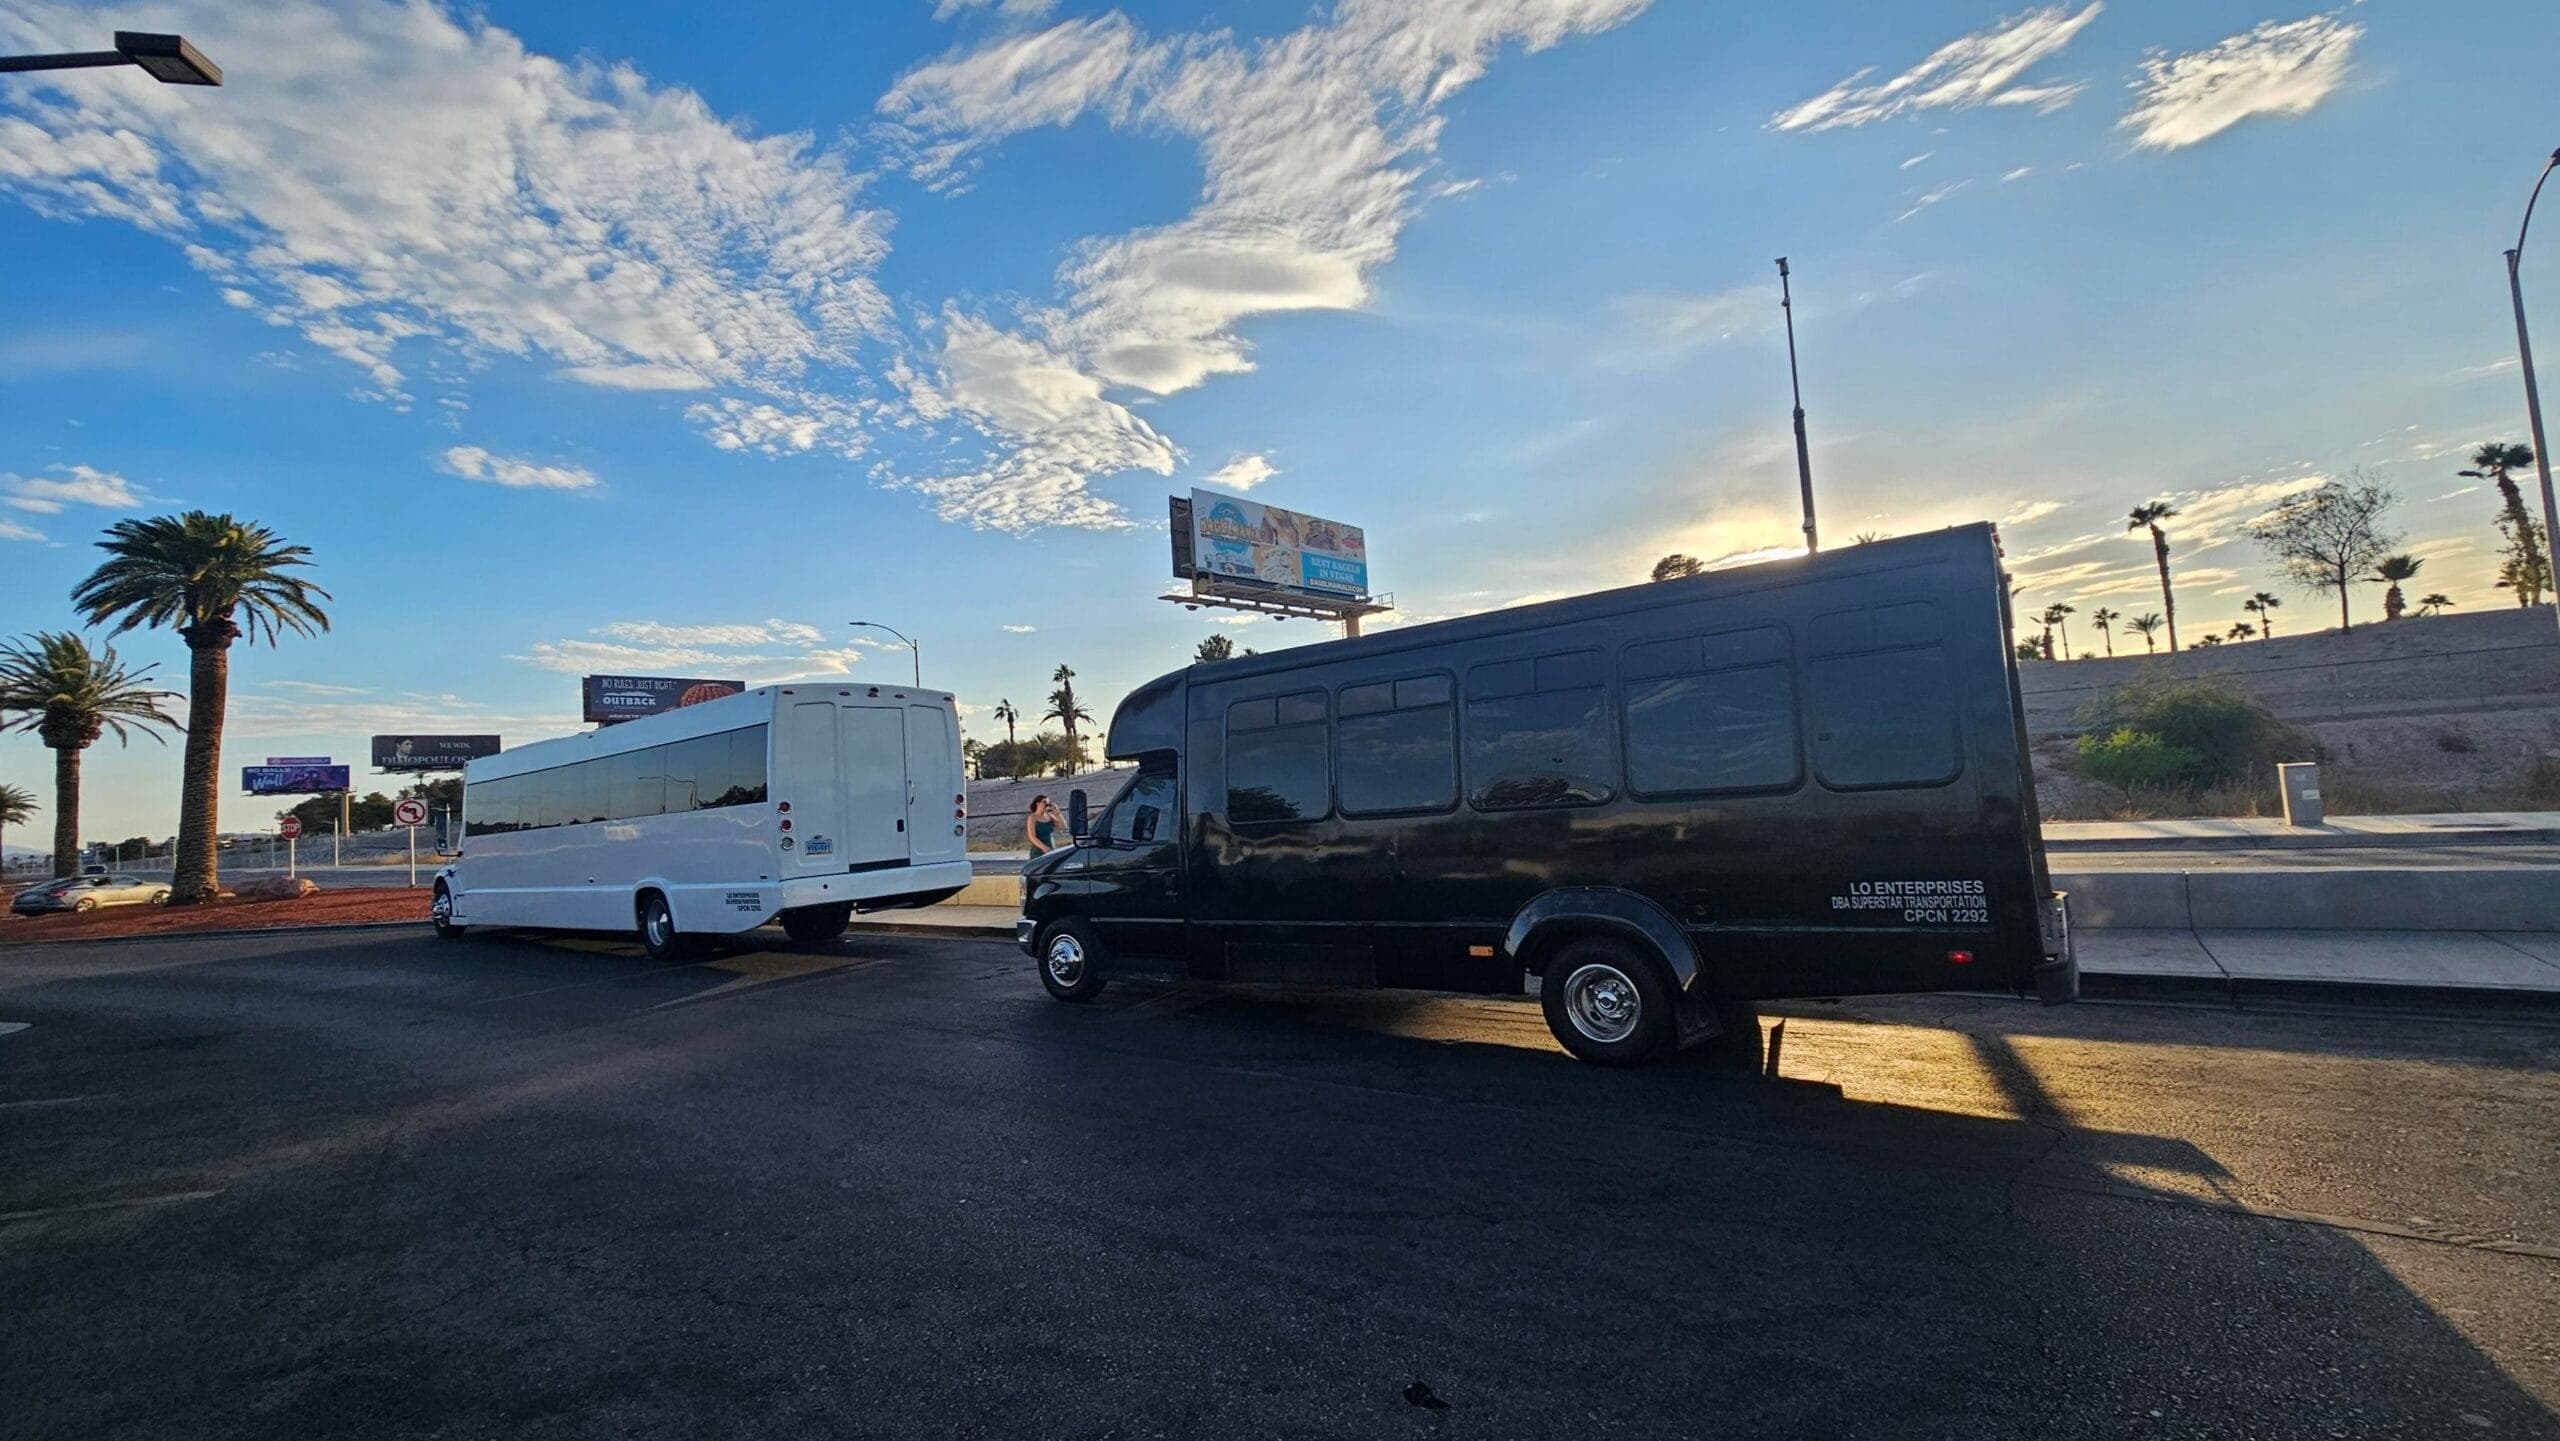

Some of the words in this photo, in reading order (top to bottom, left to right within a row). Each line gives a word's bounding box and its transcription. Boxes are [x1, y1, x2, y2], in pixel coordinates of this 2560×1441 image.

[1311, 556, 1330, 568] BEST
[1332, 560, 1360, 574] BAGELS
[1319, 568, 1329, 578] IN
[1330, 570, 1354, 583] VEGAS
[602, 679, 612, 689] NO
[636, 680, 652, 690] JUST
[603, 697, 656, 705] OUTBACK
[252, 773, 284, 790] Wall
[282, 823, 300, 833] STOP
[1850, 882, 1871, 895] LO
[1874, 880, 1985, 895] ENTERPRISES
[1832, 896, 1850, 909] DBA
[1851, 896, 1903, 909] SUPERSTAR
[1904, 895, 1987, 909] TRANSPORTATION
[1904, 909, 1948, 922] CPCN
[1952, 909, 1989, 922] 2292
